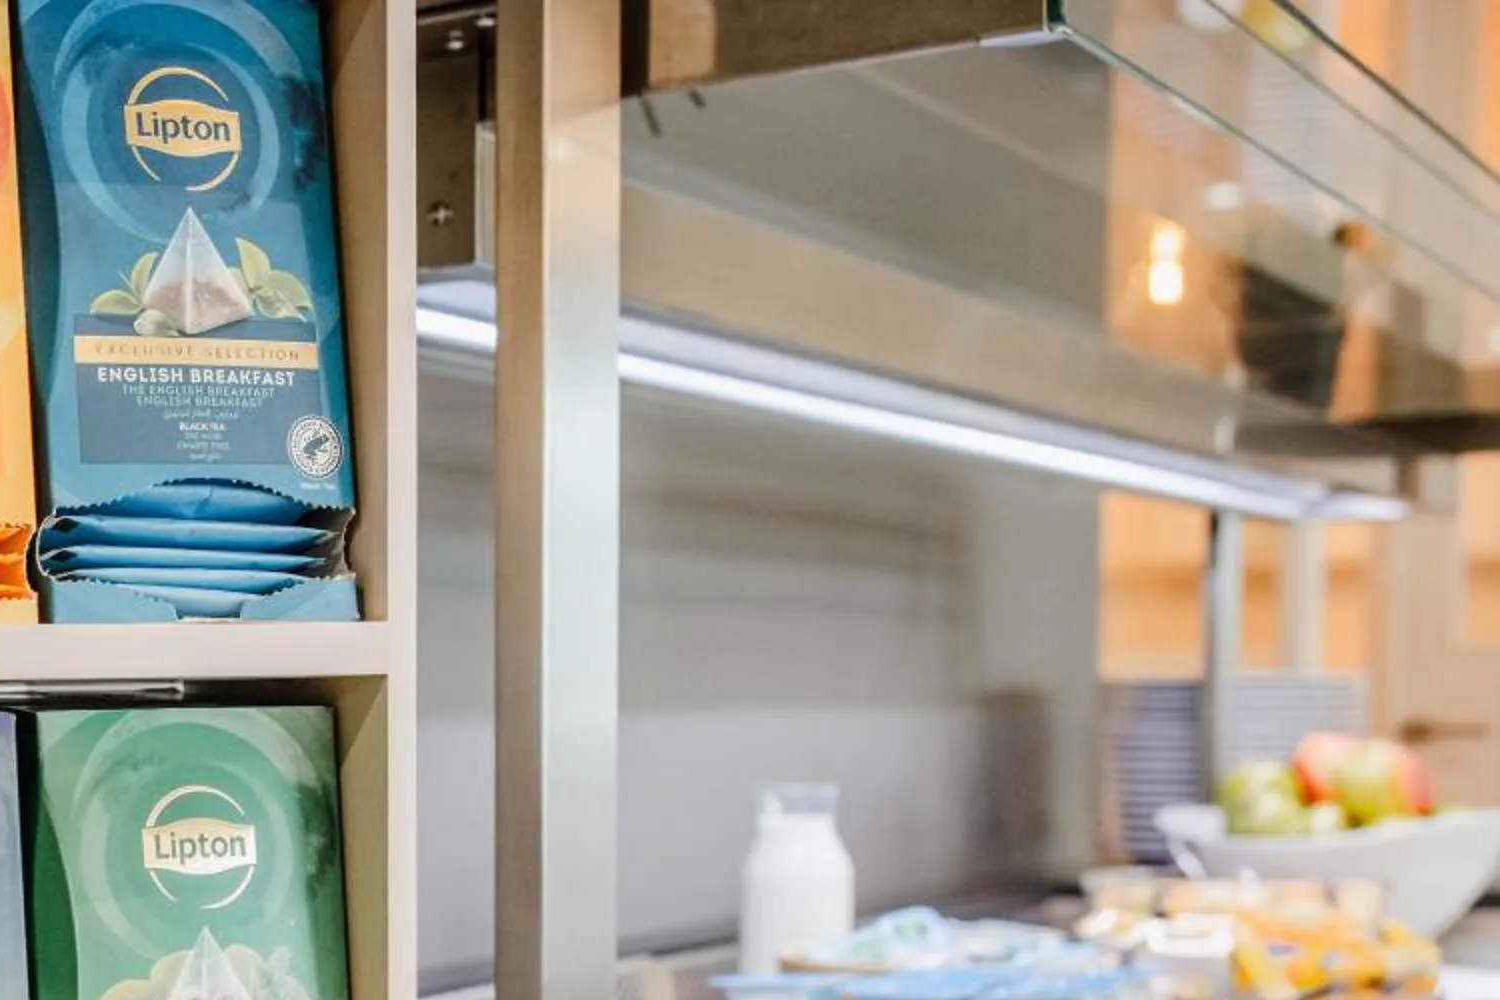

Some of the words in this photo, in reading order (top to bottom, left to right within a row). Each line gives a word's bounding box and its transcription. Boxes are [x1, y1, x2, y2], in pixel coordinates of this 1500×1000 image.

[135, 110, 231, 144] Lipton
[95, 342, 193, 358] EXCLUSIVE
[204, 345, 300, 362] SELECTION
[97, 366, 183, 383] ENGLISH
[190, 368, 297, 387] BREAKFAST
[149, 384, 204, 397] ENGLISH
[207, 386, 276, 399] BREAKFAST
[136, 395, 191, 407] ENGLISH
[194, 397, 265, 409] BREAKFAST
[154, 831, 247, 865] Lipton
